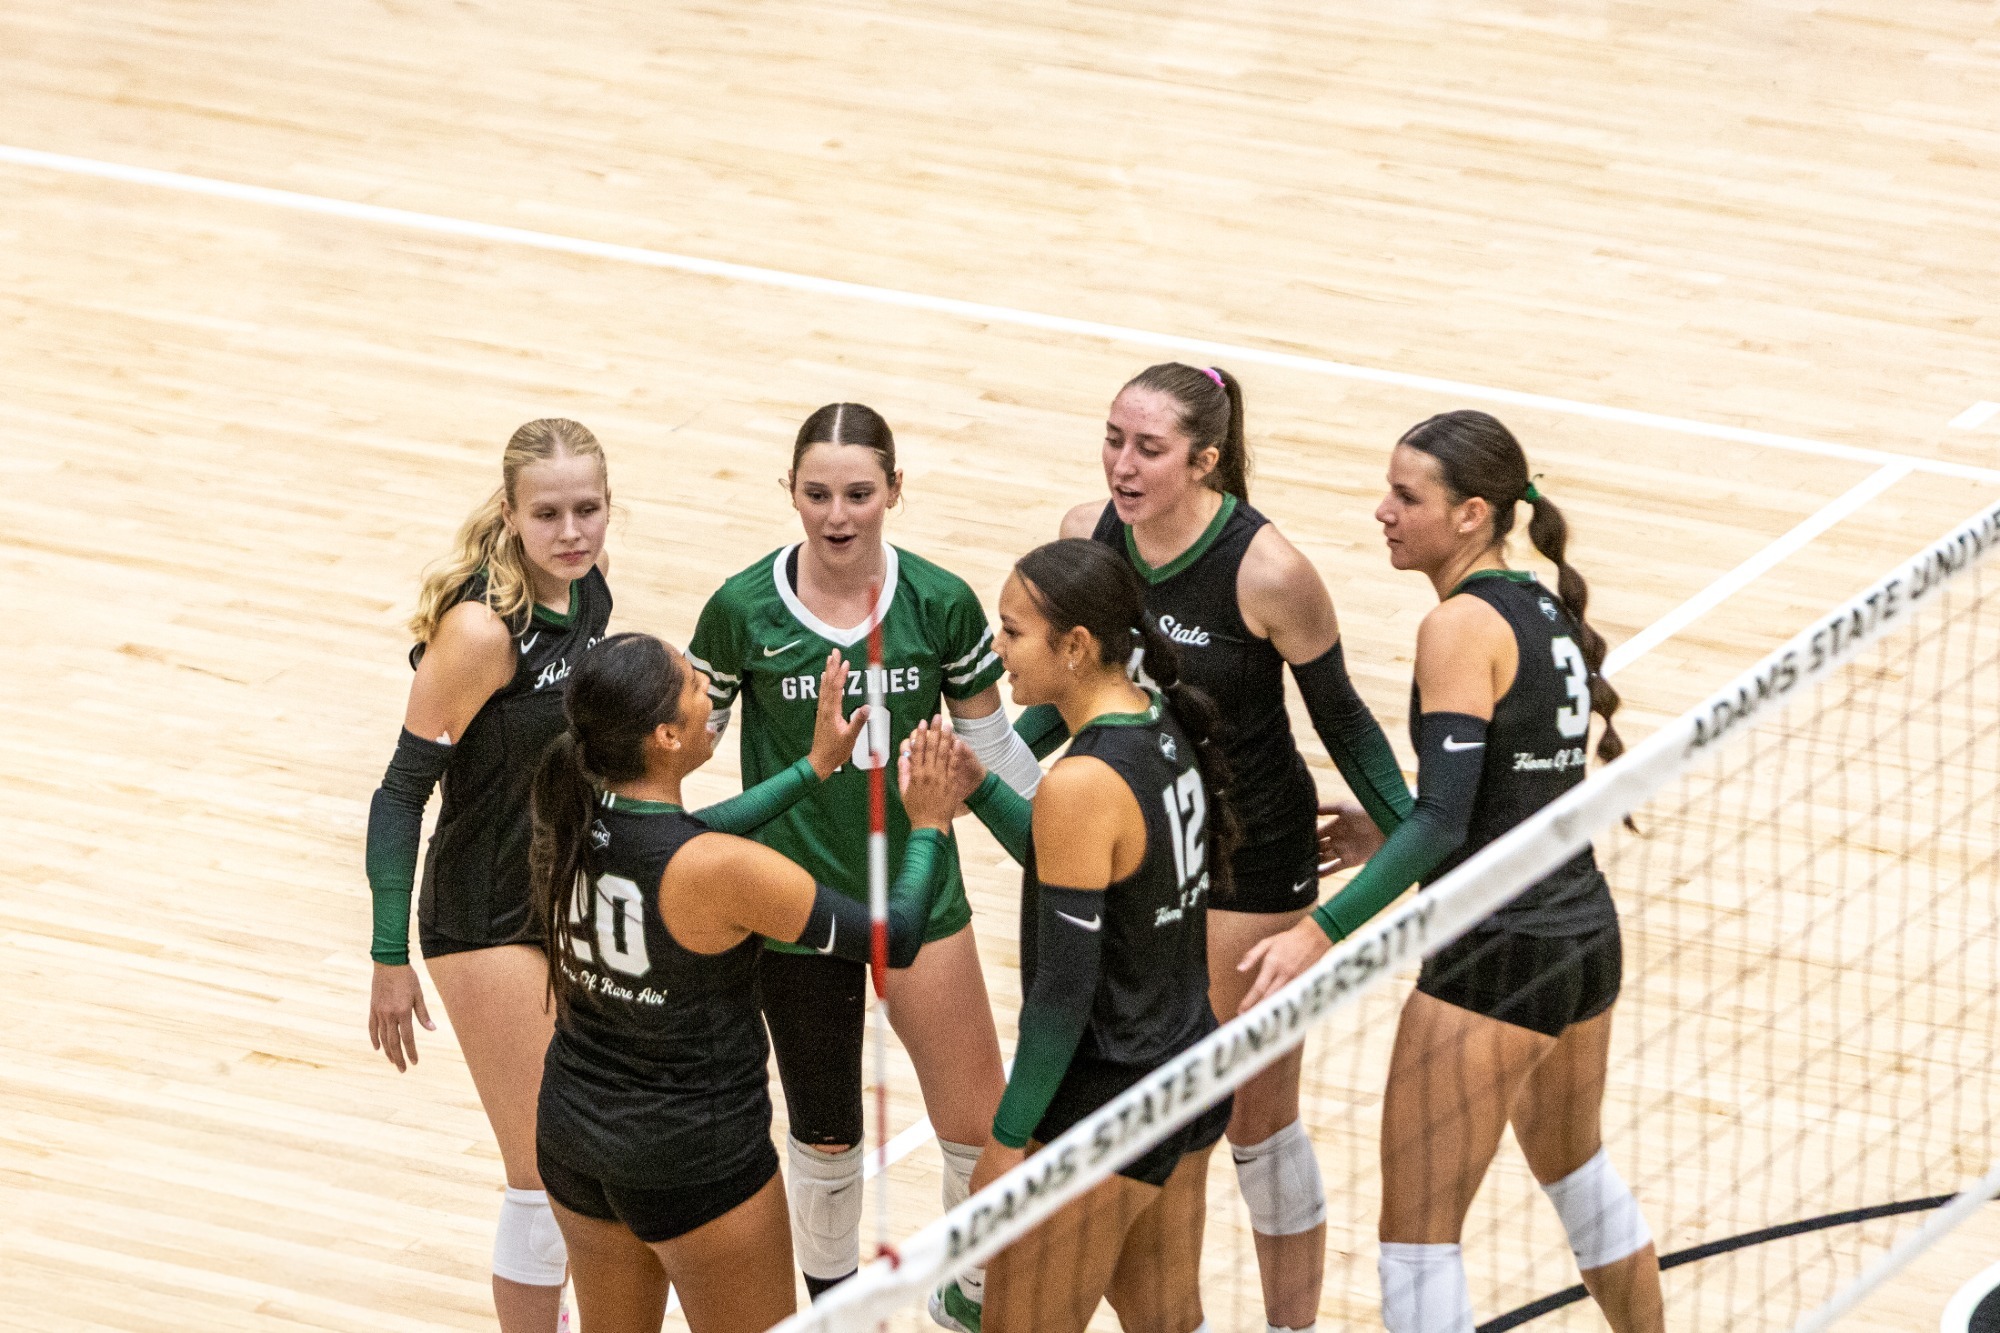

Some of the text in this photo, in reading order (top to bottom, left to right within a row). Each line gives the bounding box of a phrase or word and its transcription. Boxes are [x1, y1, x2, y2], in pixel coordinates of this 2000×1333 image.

[1159, 614, 1211, 646] State
[1682, 650, 1799, 759] ADAMS
[1807, 579, 1902, 673] STATE
[1551, 635, 1590, 738] 3
[1162, 766, 1206, 888] 12
[600, 976, 634, 1000] Rare
[943, 899, 1437, 1262] ADAMS STATE UNIVERSITY
